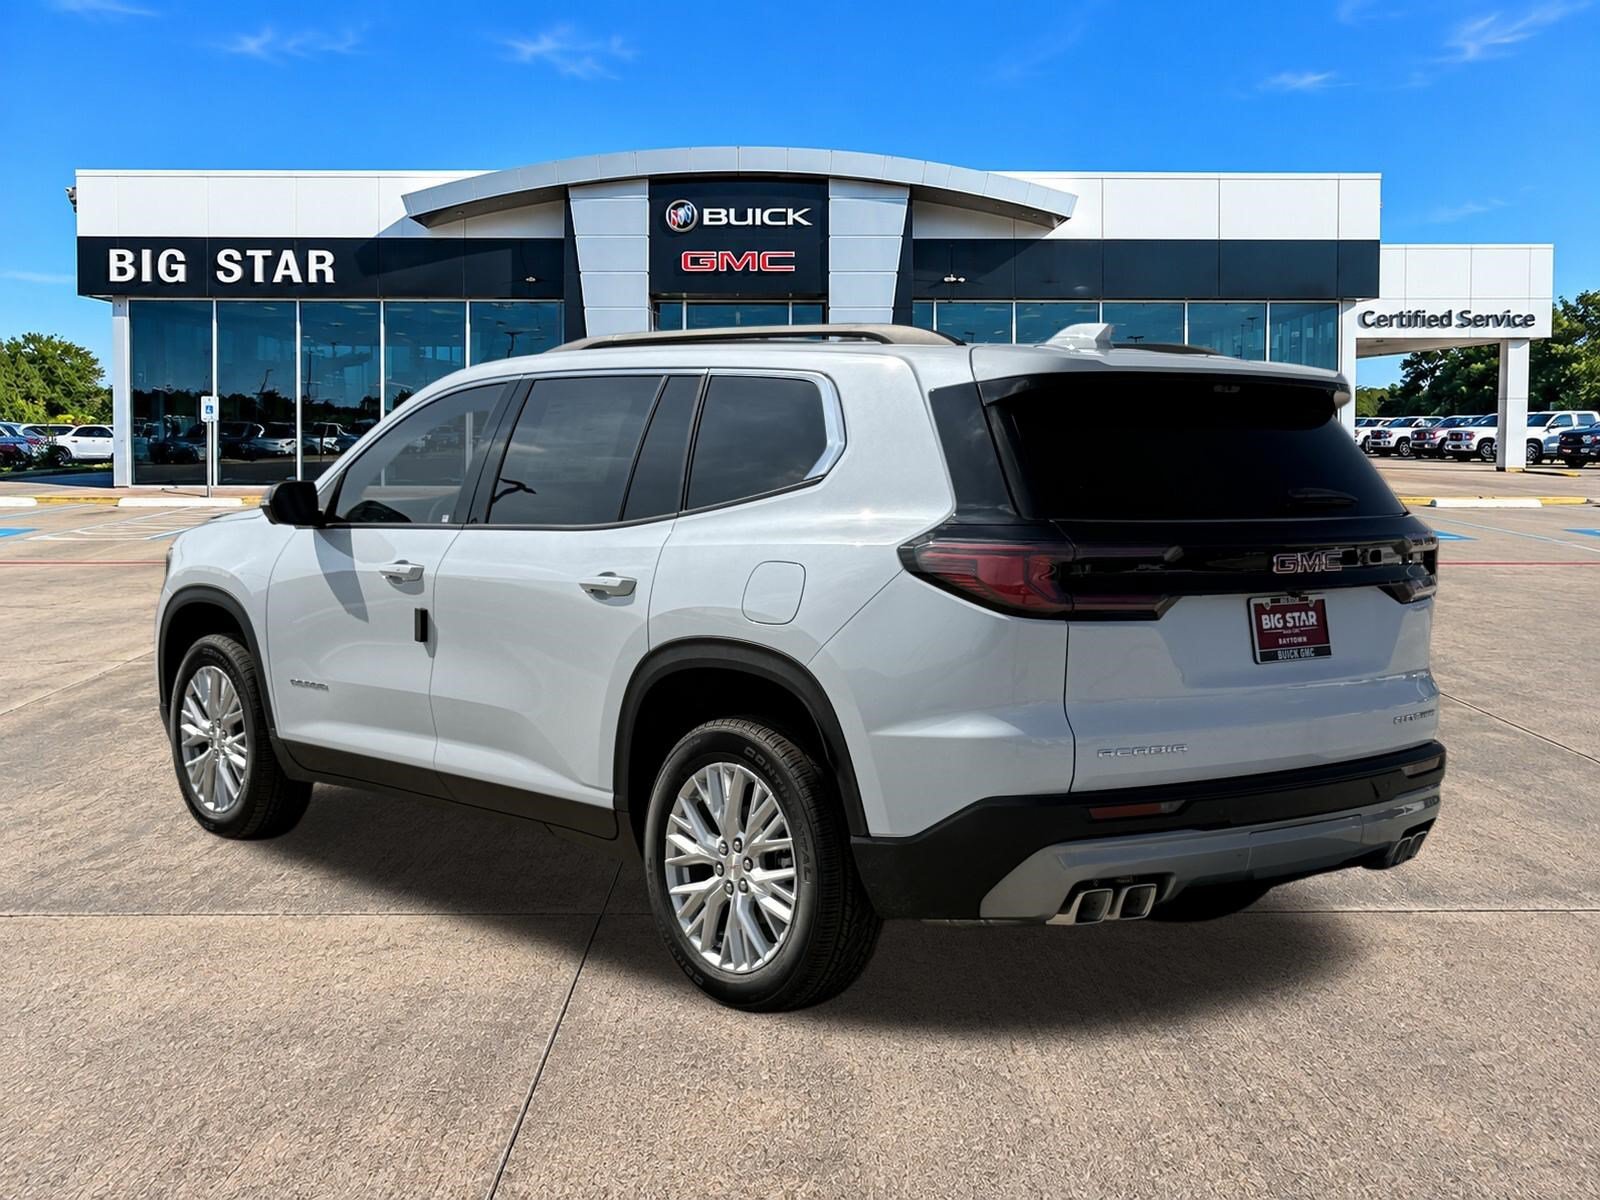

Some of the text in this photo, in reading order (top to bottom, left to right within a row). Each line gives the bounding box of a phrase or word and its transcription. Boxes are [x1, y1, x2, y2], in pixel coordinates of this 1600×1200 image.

[703, 207, 813, 226] BUICK
[108, 248, 335, 283] BIG STAR
[681, 250, 796, 272] GMC
[1358, 310, 1536, 329] Certified Service
[1273, 550, 1343, 574] GMC
[1261, 611, 1317, 629] BIG STAR
[1278, 636, 1307, 645] BAYTOWN
[1277, 648, 1315, 660] BUICK GMC
